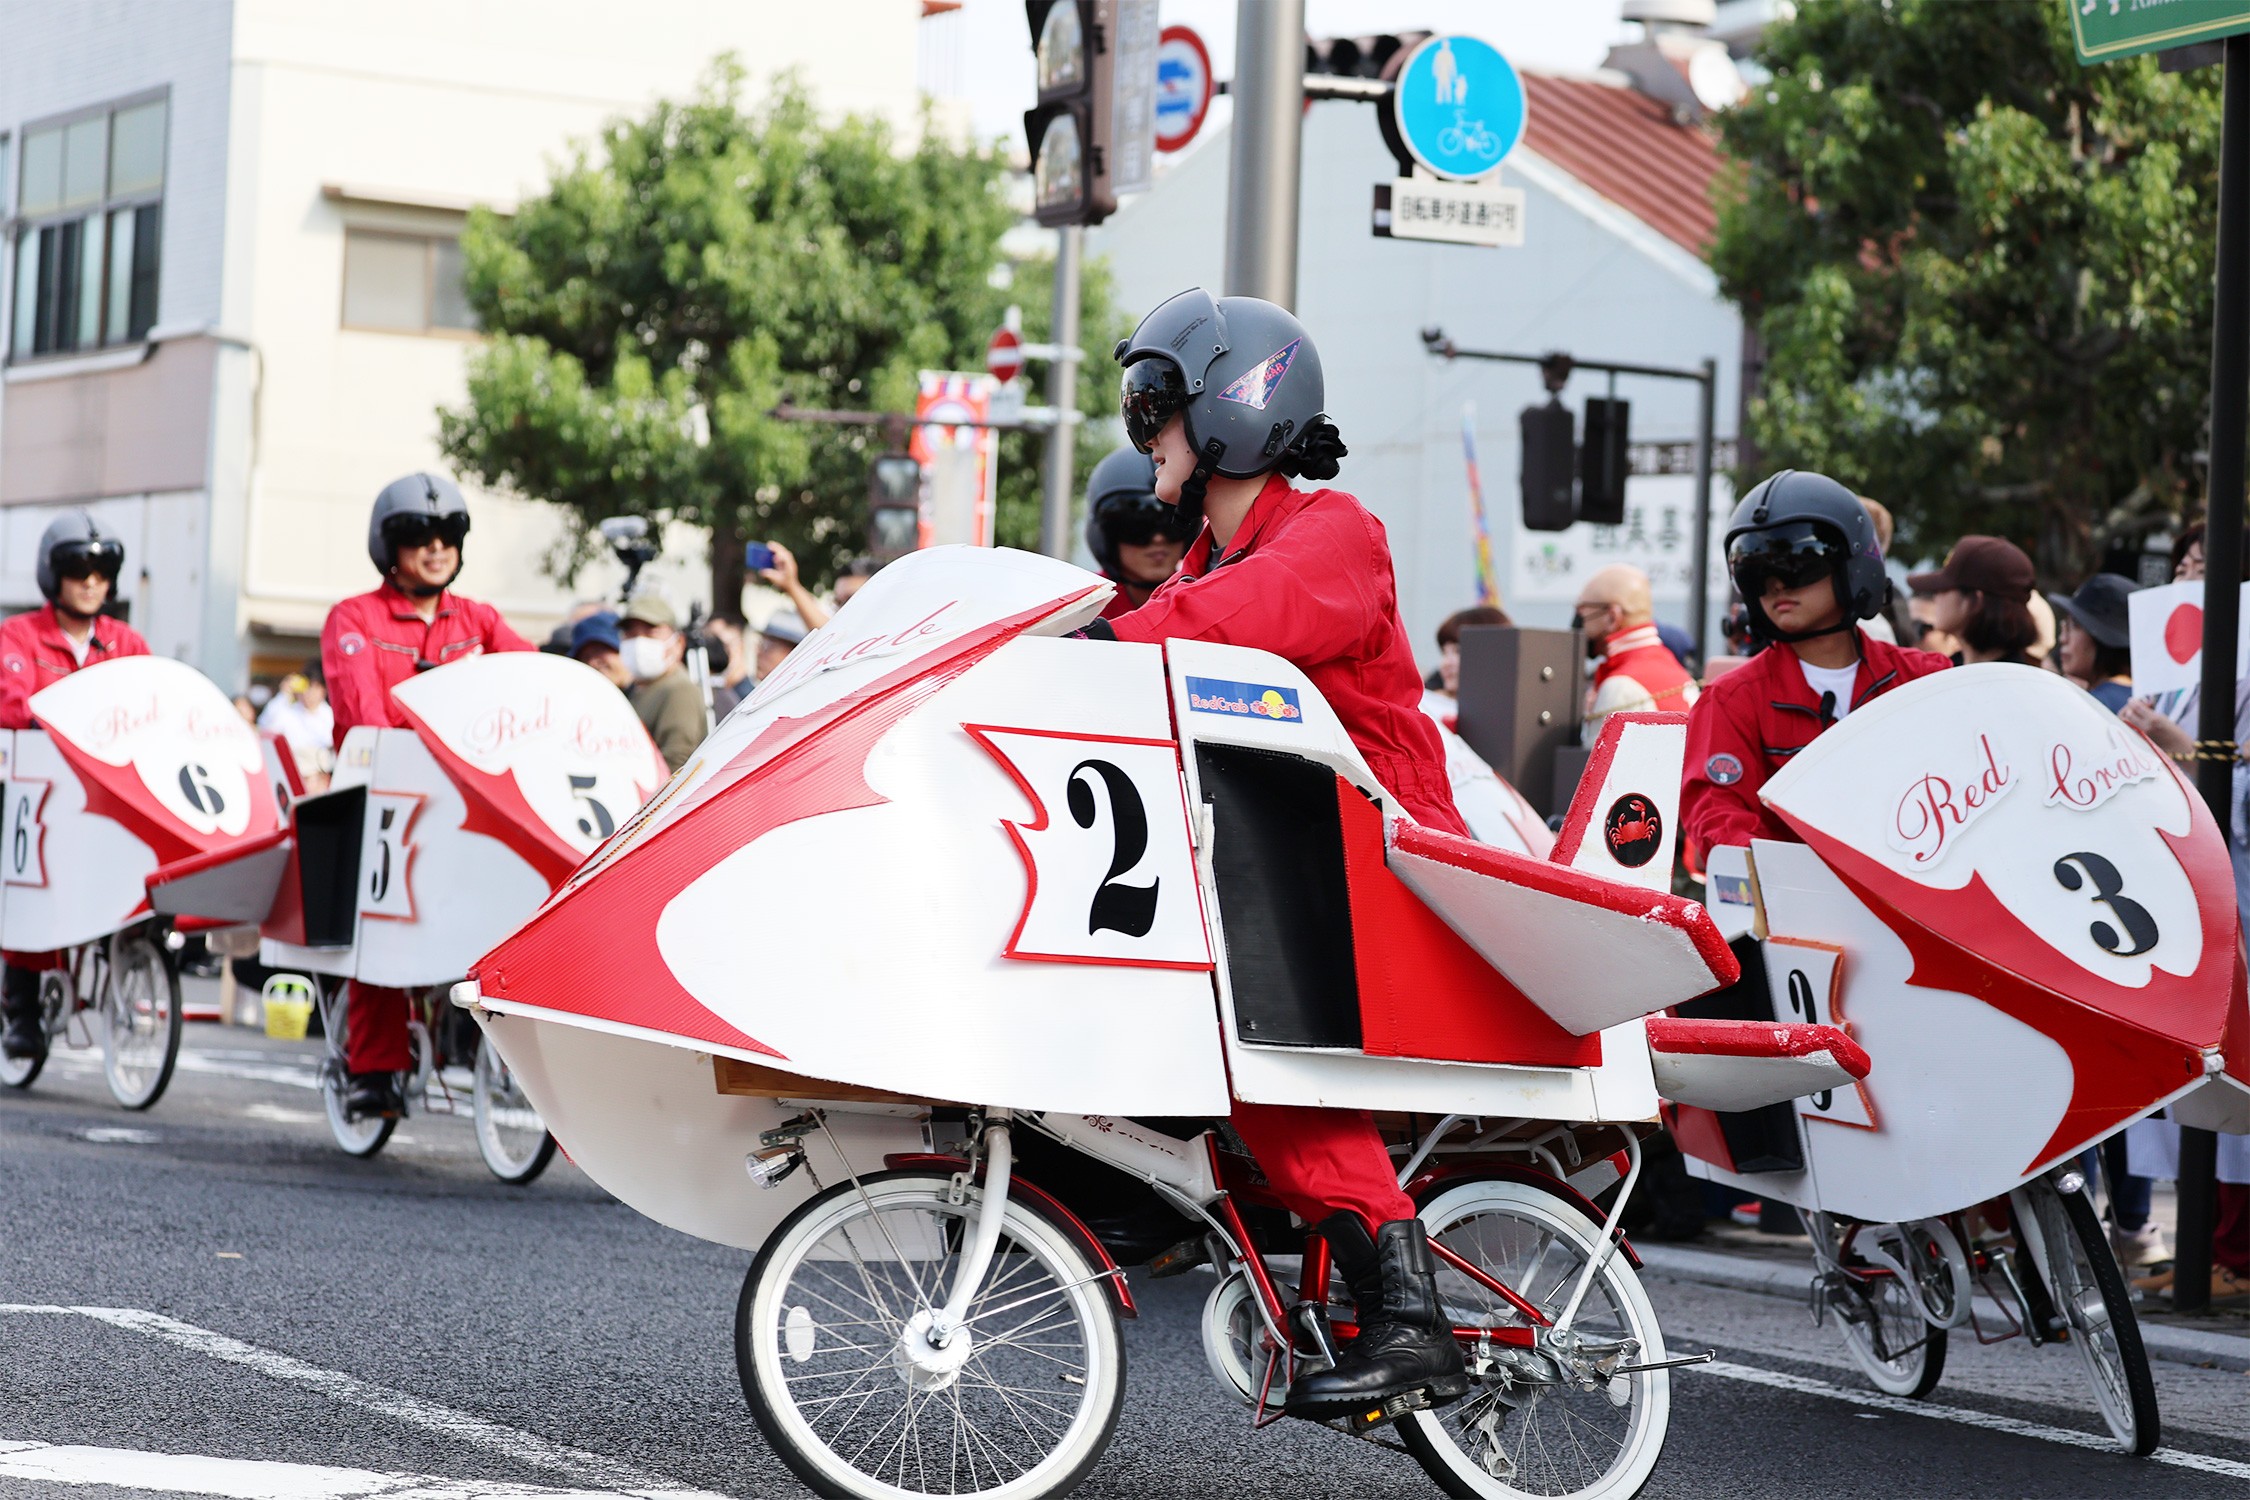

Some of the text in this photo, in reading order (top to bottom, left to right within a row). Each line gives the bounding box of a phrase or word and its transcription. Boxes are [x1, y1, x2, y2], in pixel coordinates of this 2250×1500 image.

[1401, 195, 1517, 231] 自転車歩道通行可
[472, 695, 553, 755] Red
[1190, 693, 1249, 714] RedCrab
[179, 763, 225, 815] 6
[567, 774, 615, 840] 5
[1896, 730, 2152, 863] Red Crab
[14, 795, 29, 874] 6
[371, 809, 395, 902] 5
[1066, 759, 1160, 938] 2
[2053, 851, 2160, 957] 3
